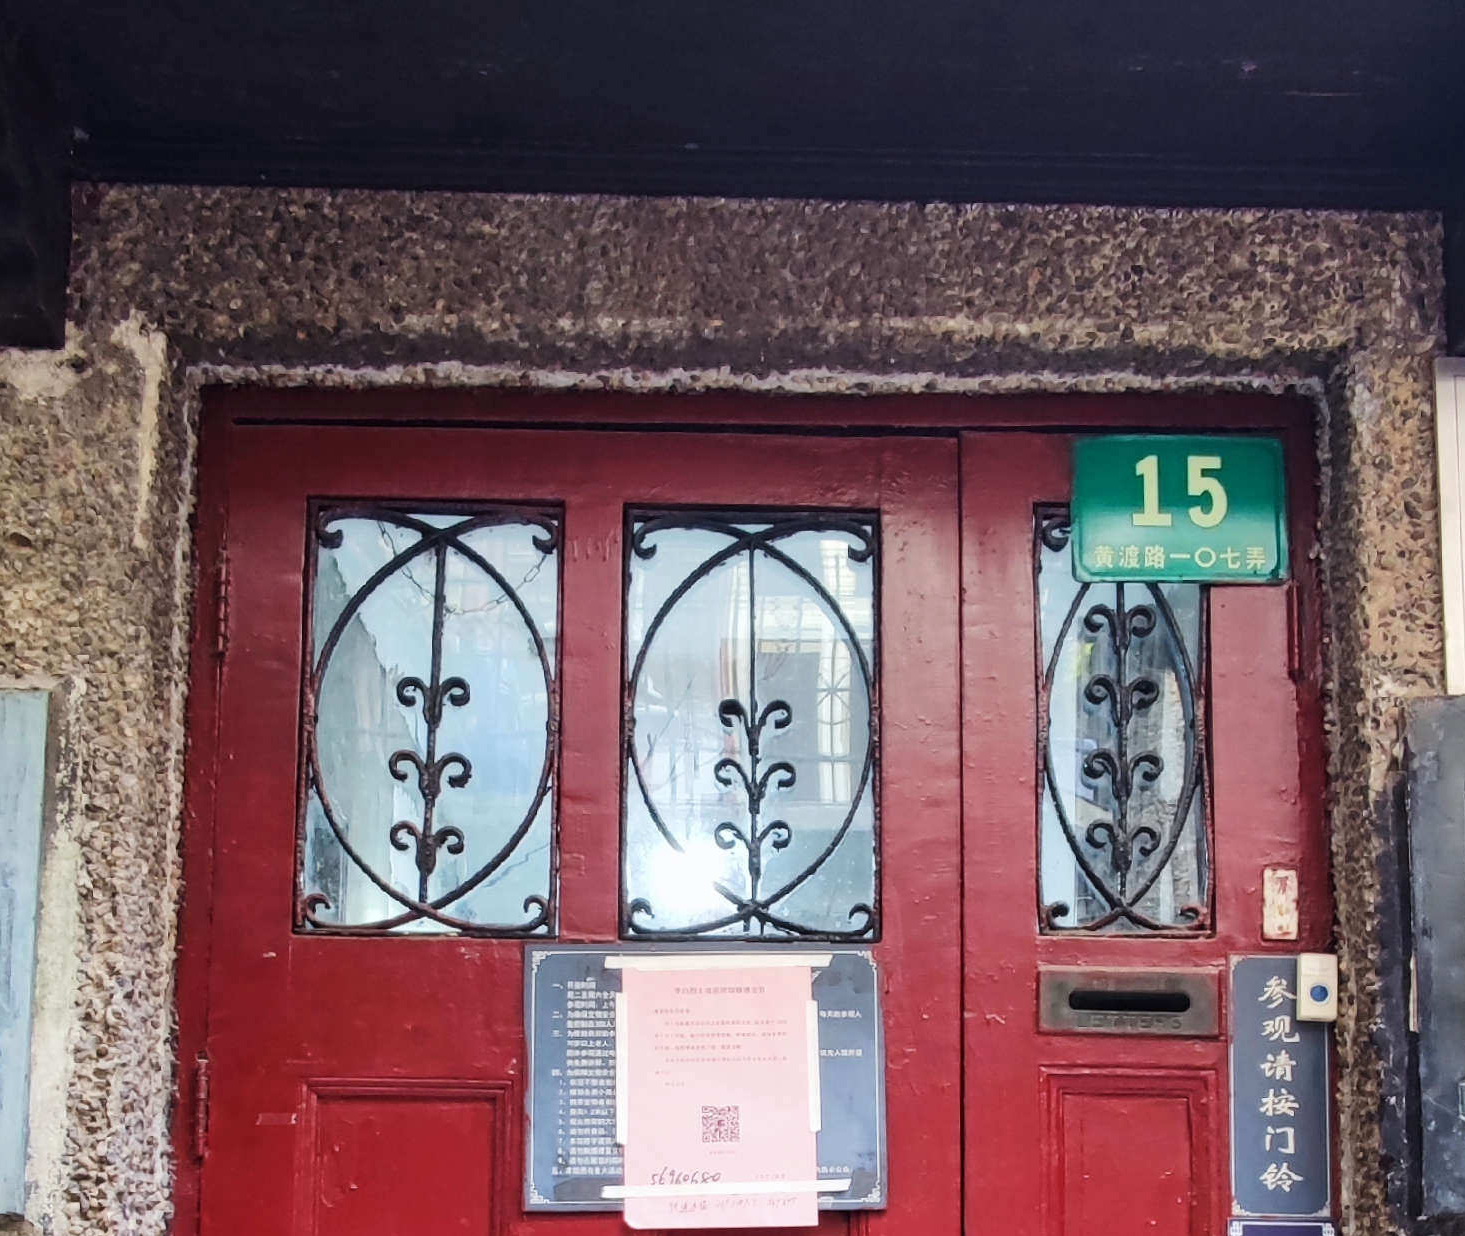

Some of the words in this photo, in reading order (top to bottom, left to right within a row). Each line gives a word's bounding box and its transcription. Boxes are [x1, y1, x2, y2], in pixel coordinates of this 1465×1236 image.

[1132, 455, 1228, 528] 15
[1258, 975, 1304, 1192] 参观请按门铃
